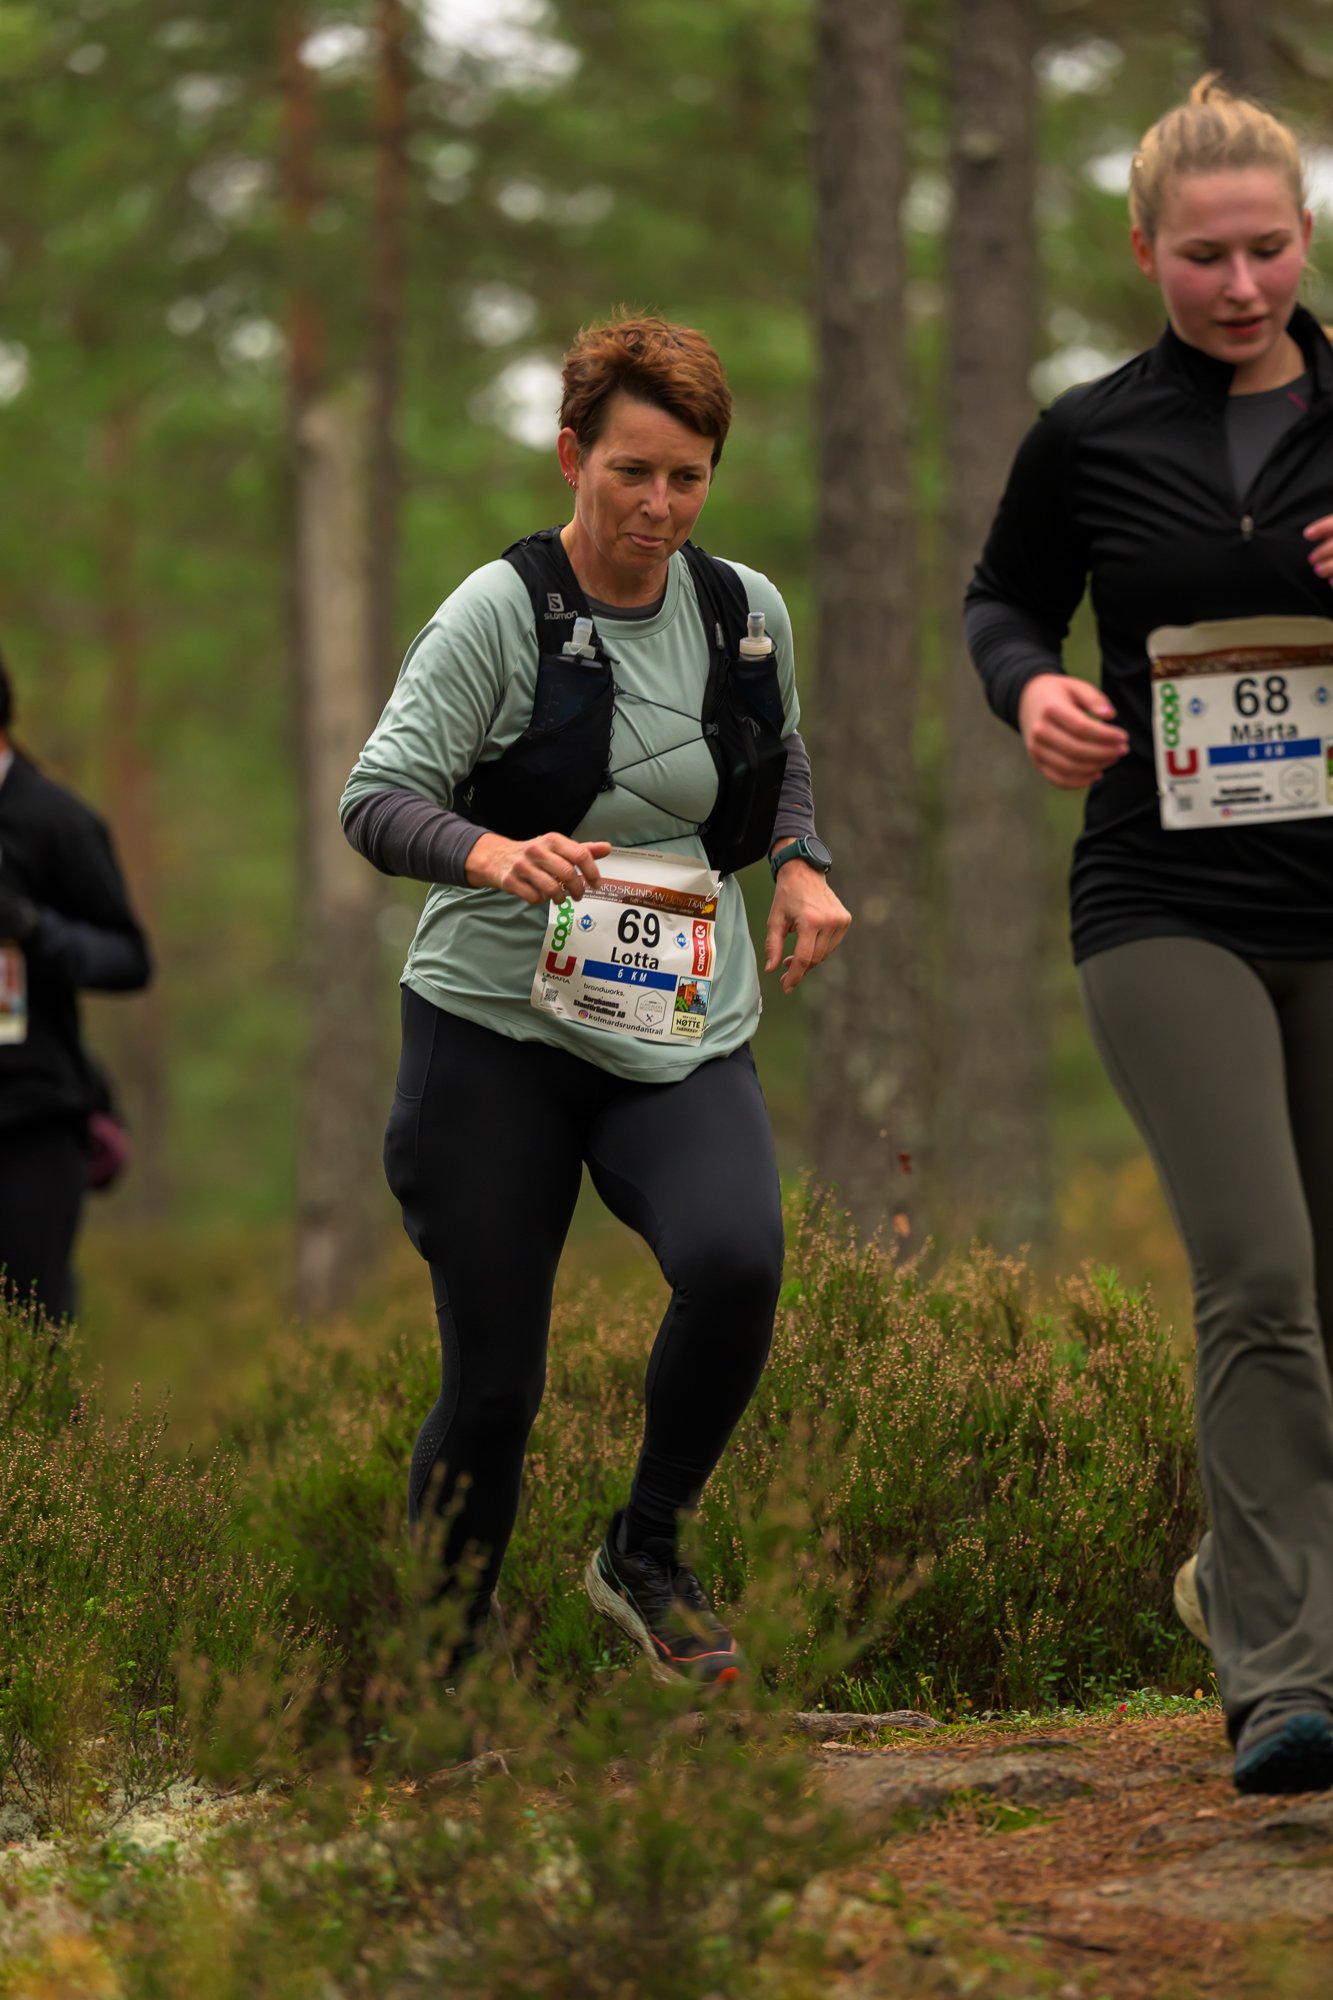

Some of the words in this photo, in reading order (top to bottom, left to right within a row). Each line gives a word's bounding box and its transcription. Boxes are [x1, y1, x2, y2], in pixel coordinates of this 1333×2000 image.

[1234, 675, 1289, 717] 68
[1231, 722, 1298, 744] Märta
[617, 908, 661, 948] 69
[696, 925, 705, 937] K
[610, 947, 659, 970] Lotta
[697, 939, 706, 972] CIRCLE
[617, 968, 624, 979] 6
[631, 970, 648, 983] KM
[588, 1013, 664, 1035] kolmardsrundantrail
